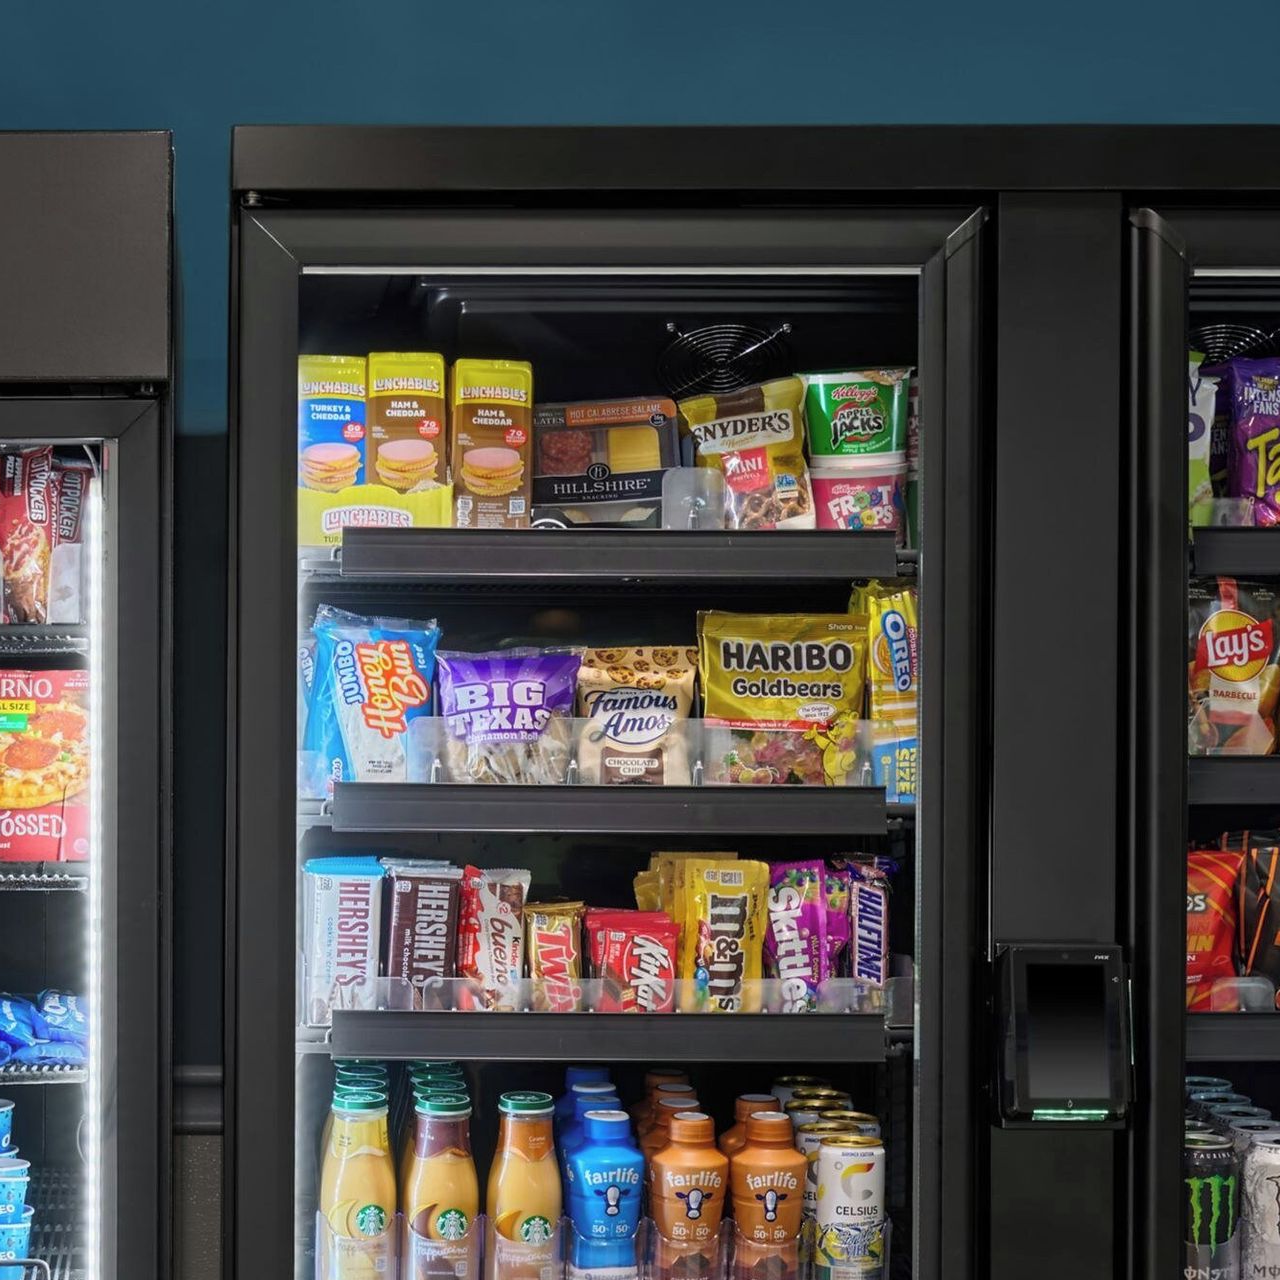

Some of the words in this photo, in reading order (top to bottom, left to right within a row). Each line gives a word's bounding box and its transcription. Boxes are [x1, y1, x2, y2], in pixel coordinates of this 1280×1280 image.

[301, 381, 366, 397] LUNCHABLES
[374, 378, 440, 392] LUNCHABLES
[460, 386, 527, 401] LUNCHABLES
[832, 385, 877, 401] Kellogg's
[311, 413, 351, 421] CHEDDAR
[386, 409, 425, 417] CHEDDAR
[472, 417, 512, 426] CHEDDAR
[570, 409, 585, 419] HOT
[587, 405, 630, 418] CALABRESE
[632, 403, 662, 414] SALAME
[838, 408, 871, 420] APPLE
[1253, 400, 1280, 416] FANS
[691, 413, 790, 443] SNYDER'S
[830, 416, 884, 449] JACKS
[554, 479, 647, 494] HILLSHIRE
[722, 642, 853, 672] HARIBO
[882, 610, 912, 692] OREO
[1205, 624, 1266, 667] Lay's
[335, 640, 365, 706] JUMBO
[390, 640, 429, 707] Bun
[358, 643, 407, 738] Honey
[454, 680, 545, 710] BIG
[584, 688, 677, 717] Famous
[732, 678, 842, 698] Goldbears
[10, 702, 30, 710] SIZE
[447, 708, 552, 736] TEXAS
[589, 711, 671, 742] Amos
[336, 881, 370, 988] HERSHEY'S
[413, 884, 450, 988] HERSHEY'S
[857, 887, 884, 985] HALFTIME
[490, 917, 512, 986] bueno
[769, 886, 814, 1013] Skittles
[836, 1206, 878, 1216] CELSIUS
